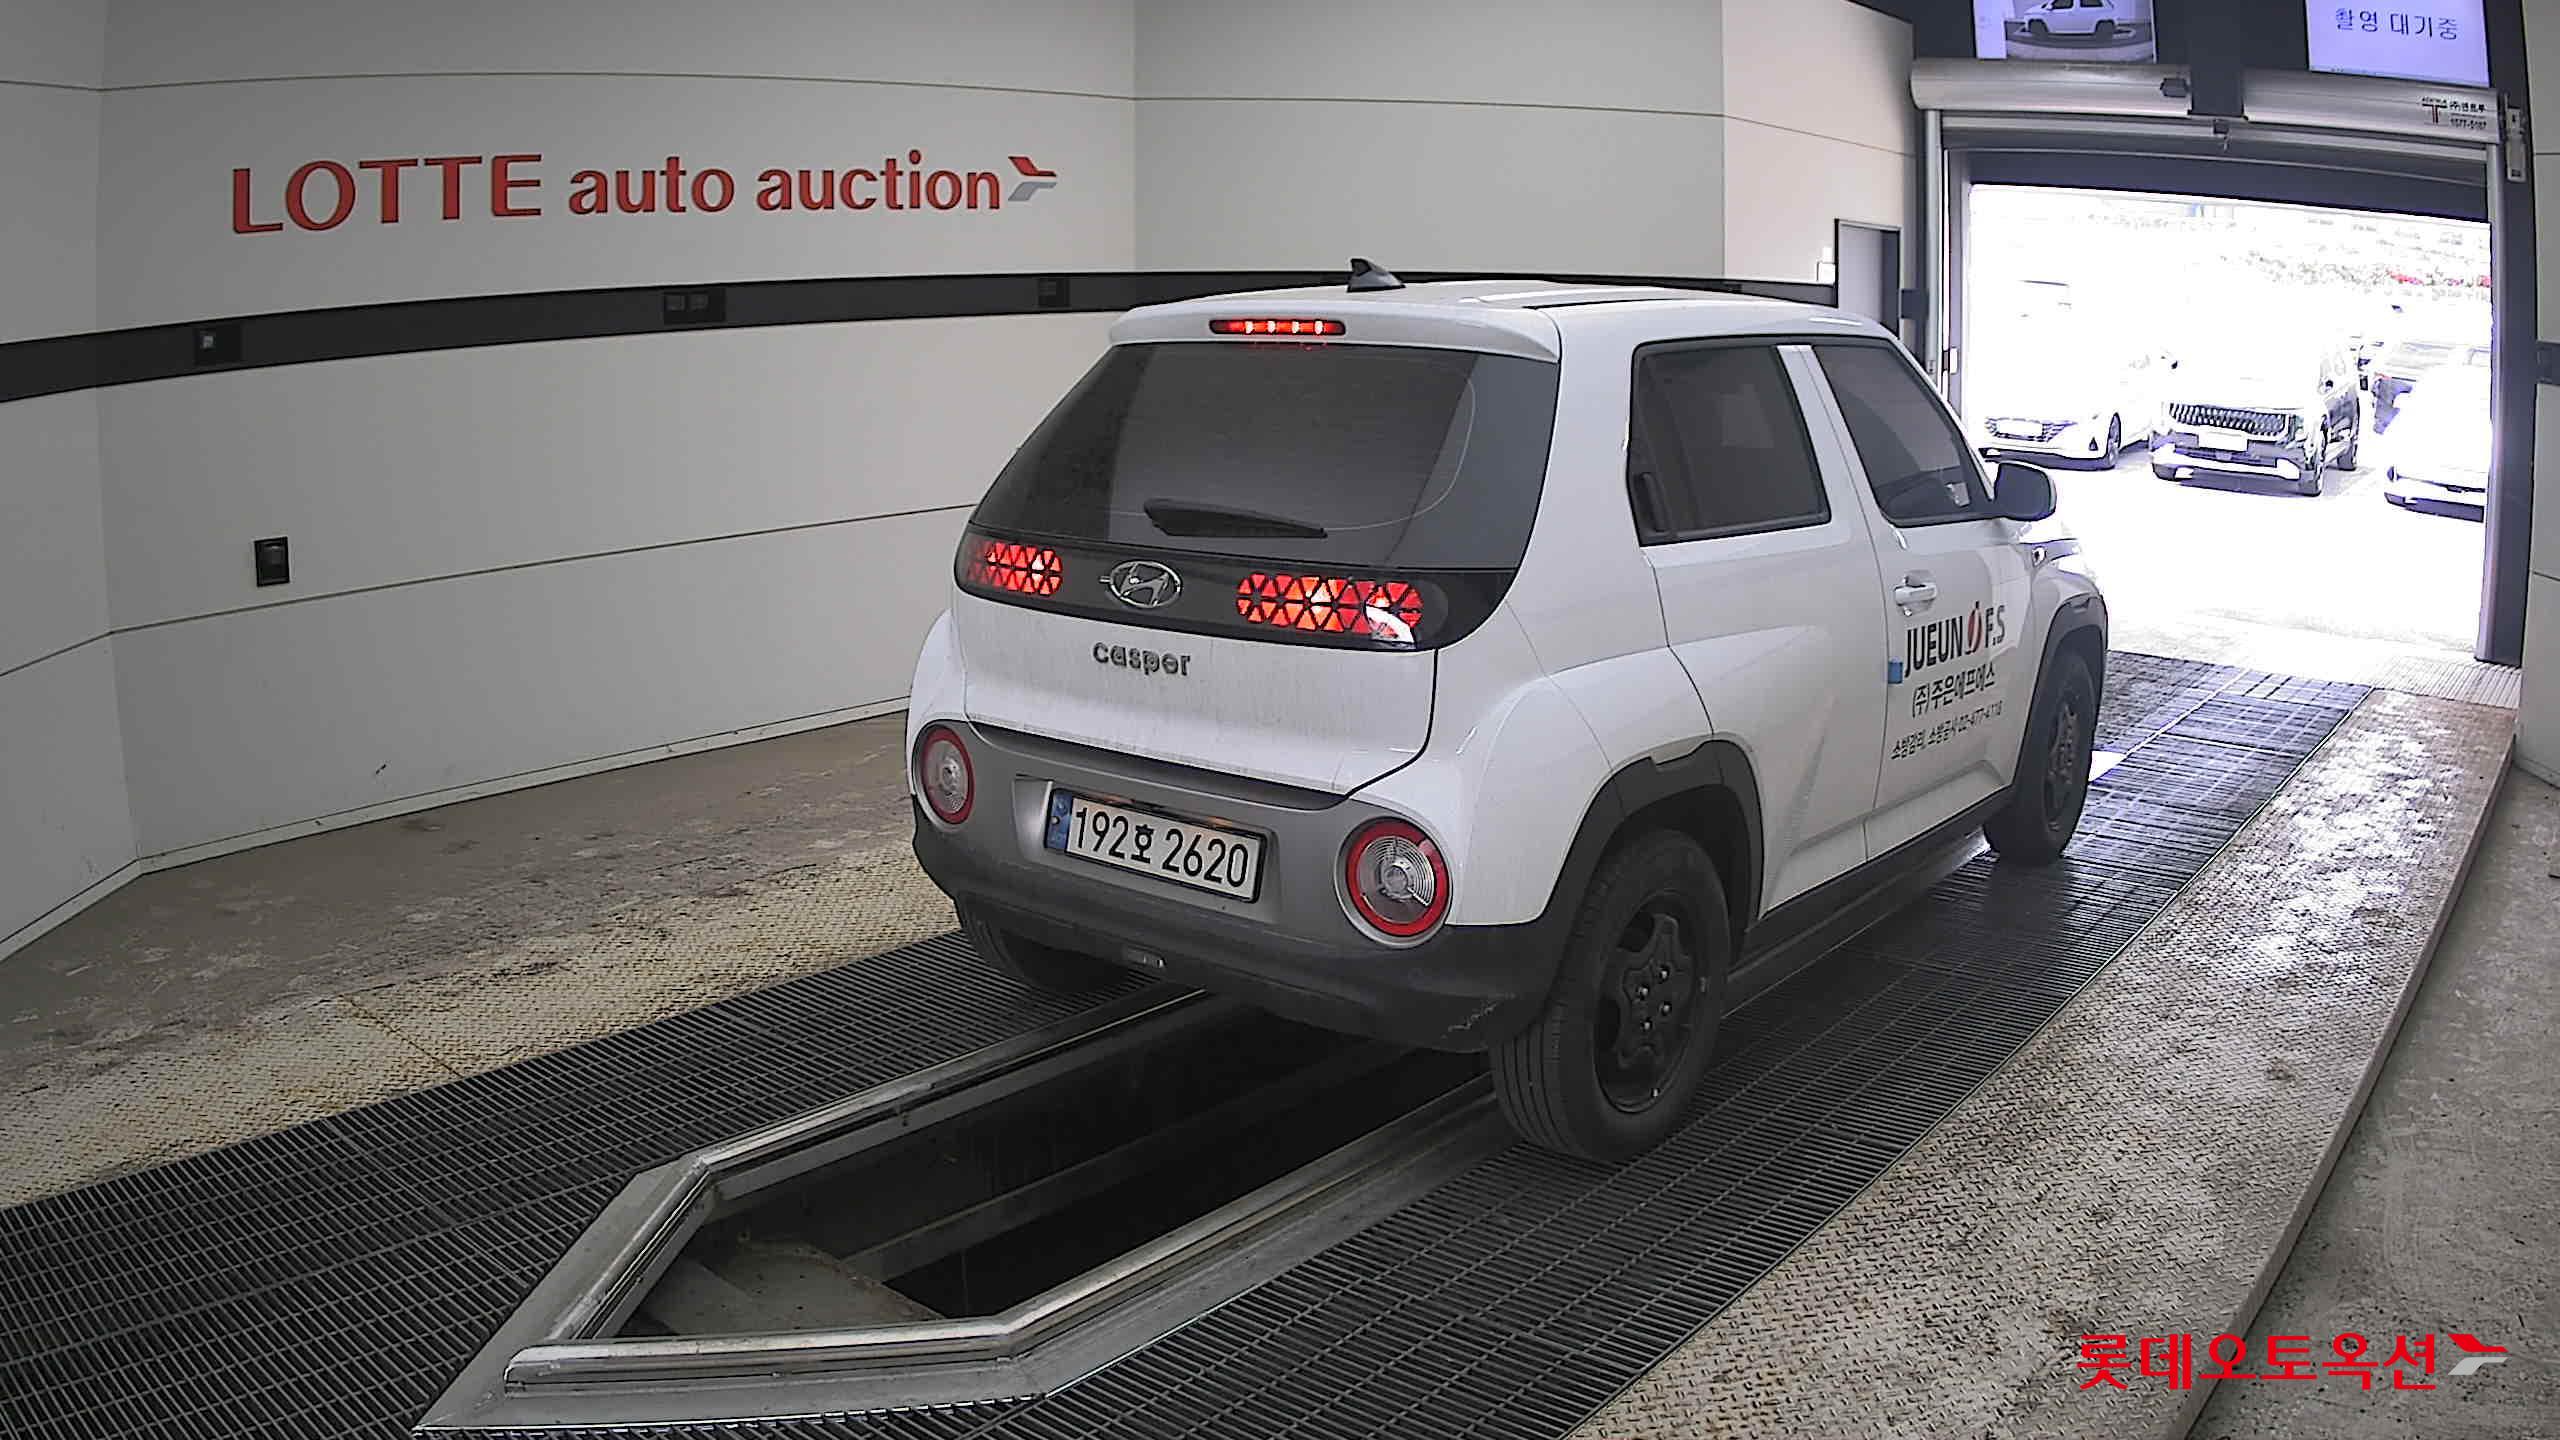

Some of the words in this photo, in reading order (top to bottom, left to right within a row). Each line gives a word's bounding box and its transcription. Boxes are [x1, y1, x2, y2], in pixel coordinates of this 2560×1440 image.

[2336, 8, 2378, 32] 촬영
[2390, 13, 2457, 40] 대기중
[233, 154, 542, 234] LOTTE
[568, 156, 735, 214] auto
[757, 149, 1001, 212] auction
[1093, 642, 1190, 676] casper
[1904, 615, 1963, 678] JUEUN
[1076, 807, 1154, 864] 192호
[1162, 829, 1249, 887] 2620
